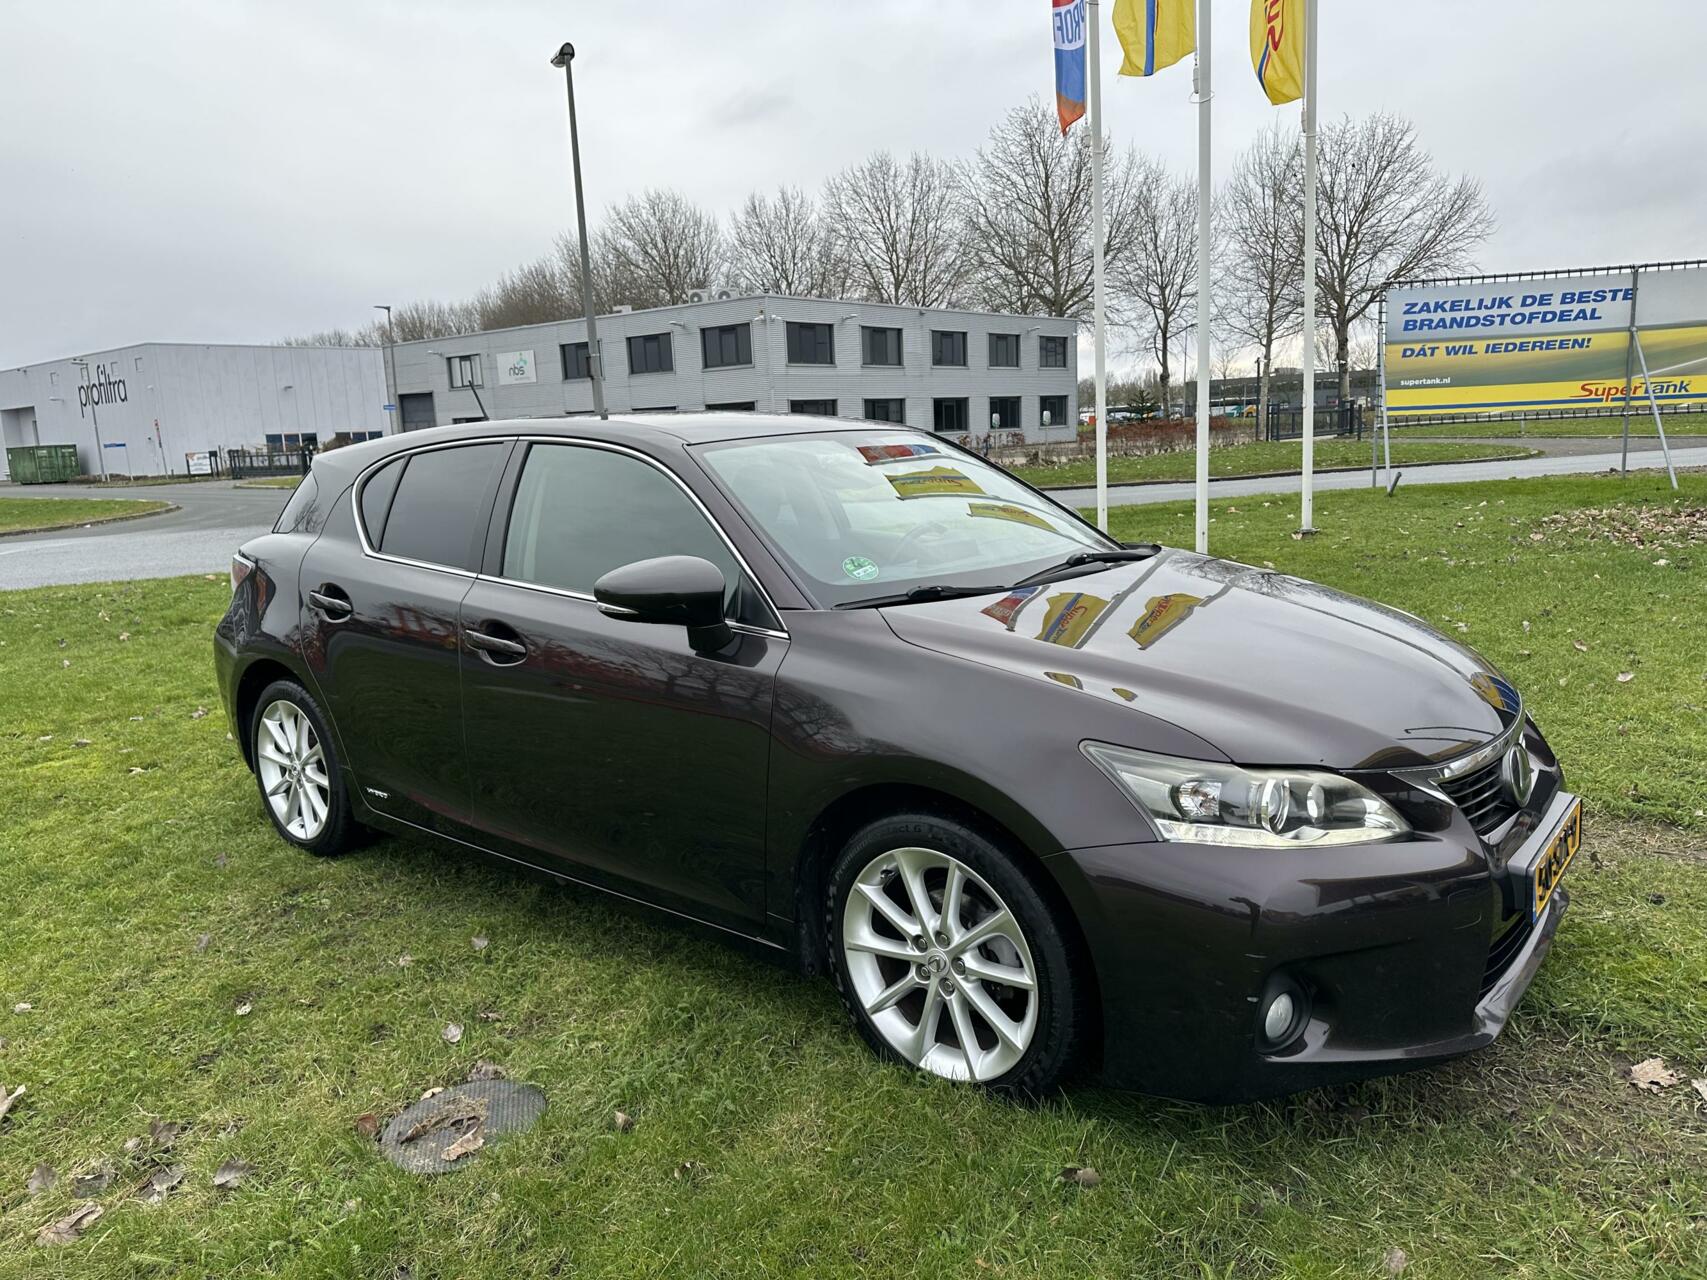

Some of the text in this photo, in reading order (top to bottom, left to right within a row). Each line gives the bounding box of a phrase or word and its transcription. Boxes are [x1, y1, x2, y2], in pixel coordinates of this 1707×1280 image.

[1403, 288, 1638, 315] ZAKELIJK DE BESTE
[1403, 308, 1602, 331] BRANDSTOFDEAL
[1402, 338, 1592, 358] DÁT WIL IEDEREEN!
[508, 363, 525, 376] nbs
[78, 364, 128, 419] profiltra
[1400, 377, 1451, 386] supertank.nl
